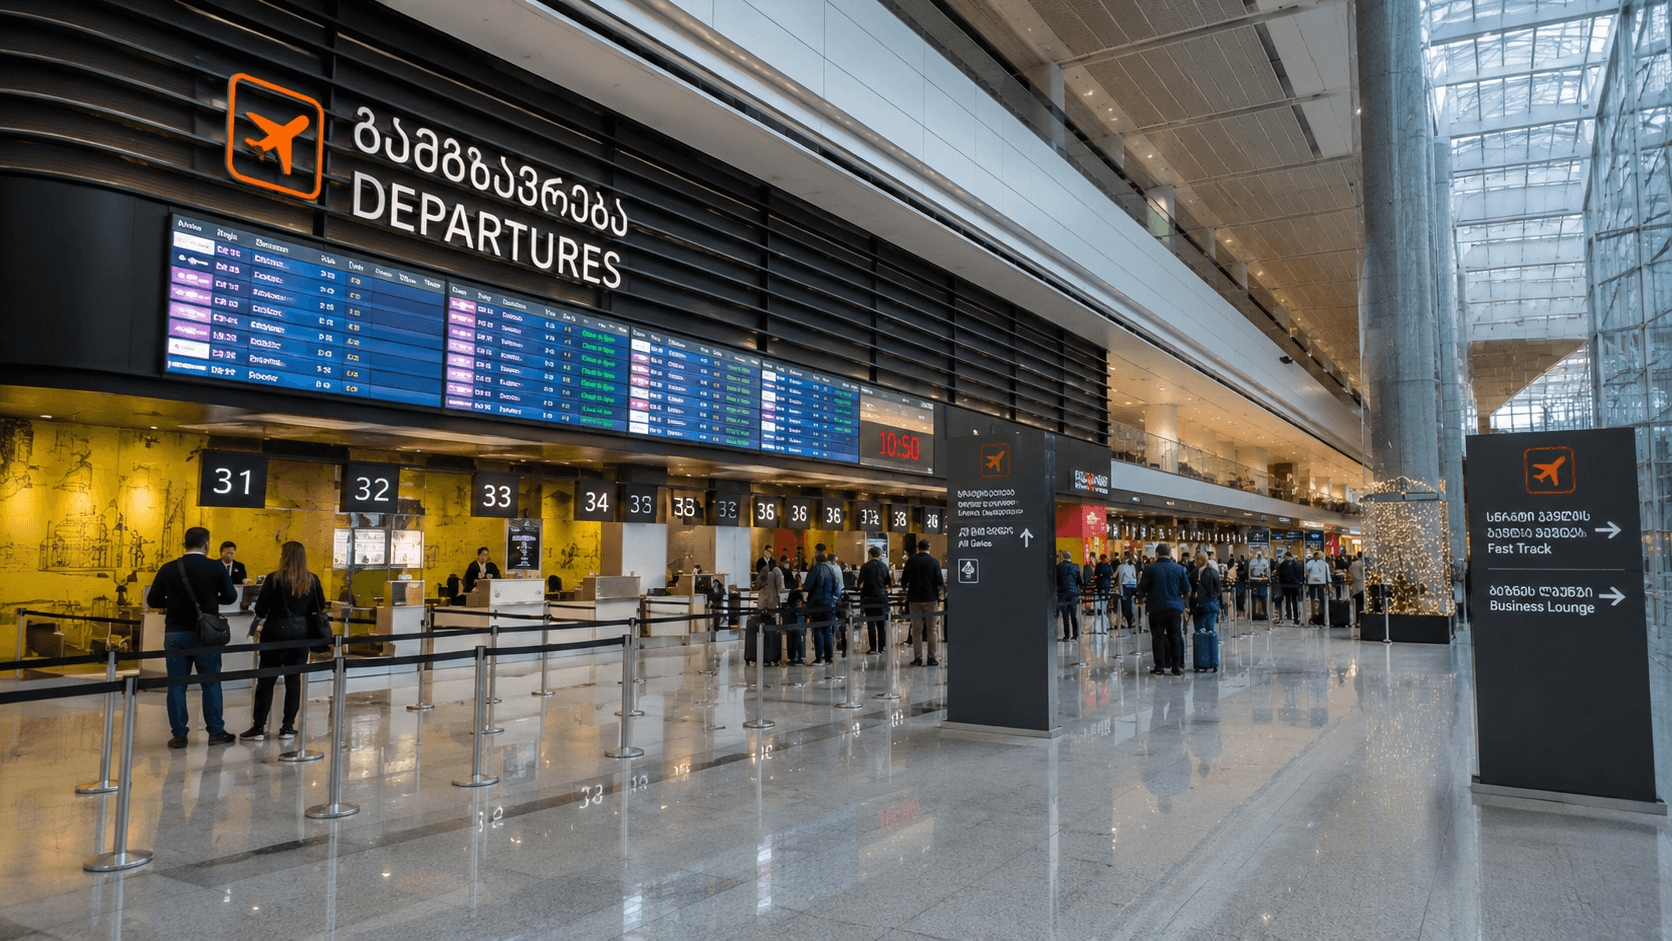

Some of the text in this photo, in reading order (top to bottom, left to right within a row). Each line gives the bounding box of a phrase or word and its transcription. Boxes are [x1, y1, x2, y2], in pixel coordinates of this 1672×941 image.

[353, 106, 629, 237] გამგზავრება
[352, 170, 622, 289] DEPARTURES
[879, 431, 920, 461] 10:50
[213, 467, 251, 495] 31
[354, 476, 390, 502] 32
[482, 484, 512, 508] 33
[585, 491, 609, 513] 34
[757, 502, 775, 521] 36
[1487, 542, 1552, 555] Fast Track
[1490, 599, 1595, 616] Business Lounge
